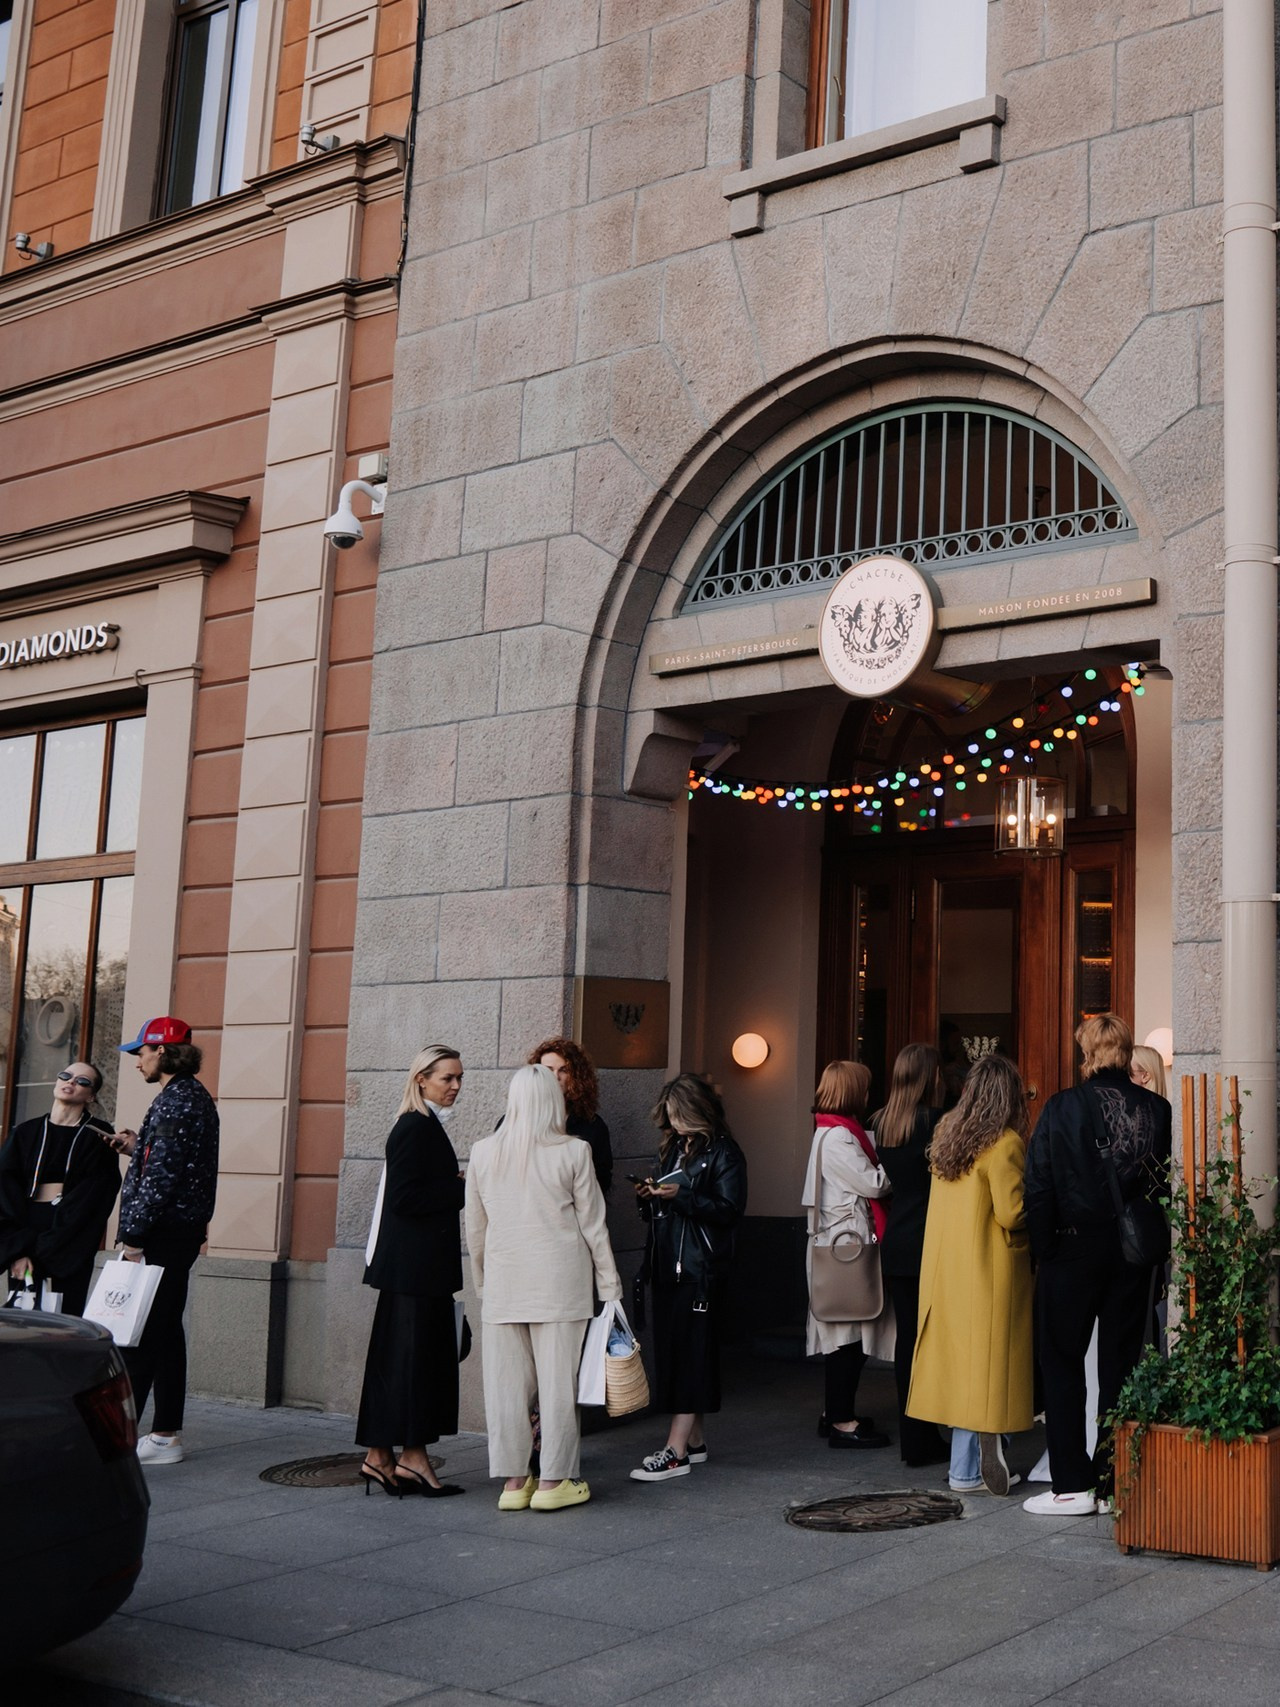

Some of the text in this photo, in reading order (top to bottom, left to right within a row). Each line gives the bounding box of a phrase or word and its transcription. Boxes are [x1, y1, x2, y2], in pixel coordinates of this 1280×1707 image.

[849, 568, 904, 590] СЧАСТЬЕ
[978, 601, 1022, 616] MAISON
[1075, 592, 1090, 602] EN
[1094, 587, 1123, 600] 2008
[0, 621, 108, 666] DIAMONDS
[665, 637, 799, 666] PARIS SAINT-PETERSBOURG
